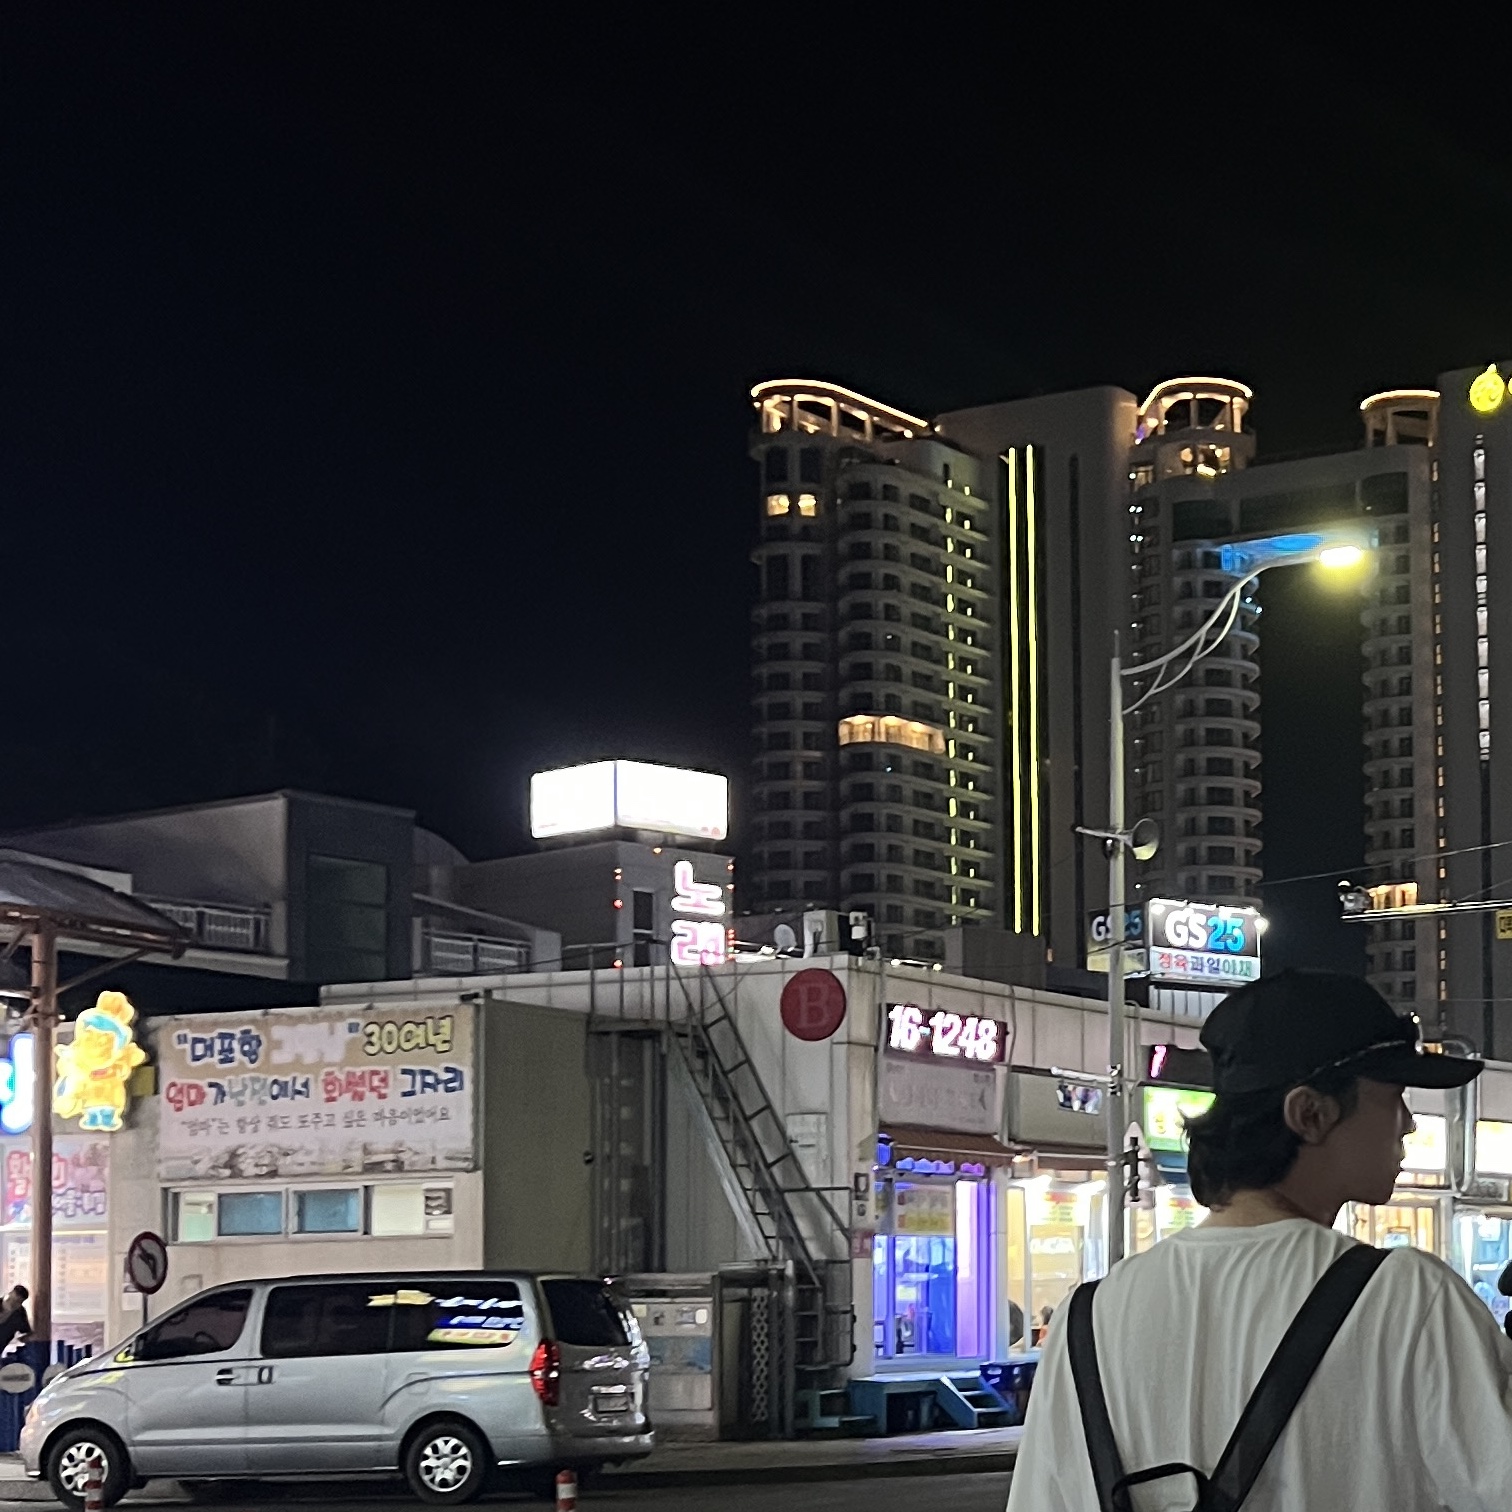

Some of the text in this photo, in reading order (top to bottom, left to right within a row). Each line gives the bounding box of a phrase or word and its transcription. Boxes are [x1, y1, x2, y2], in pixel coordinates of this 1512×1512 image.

[1164, 908, 1246, 954] GS25
[798, 983, 830, 1029] B
[363, 1014, 455, 1056] 30여년
[887, 1004, 999, 1062] 16-1248
